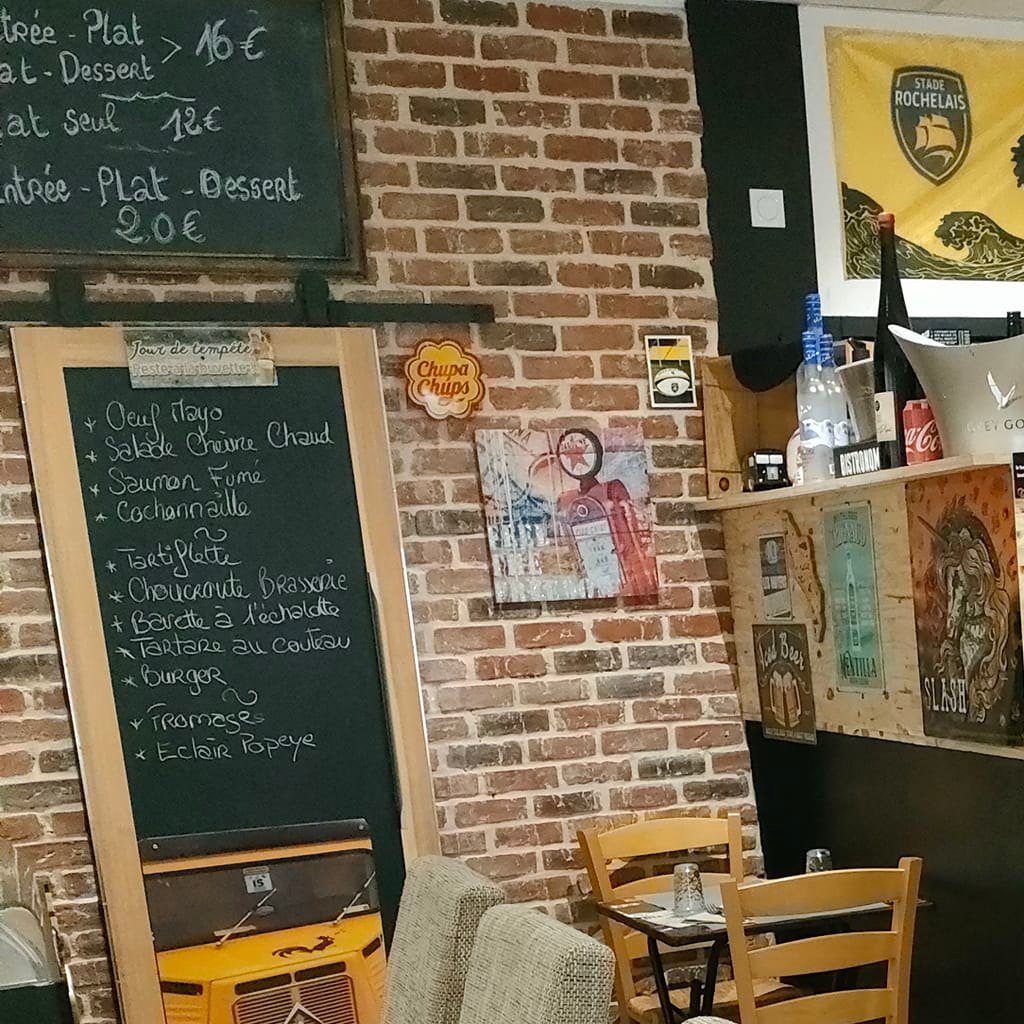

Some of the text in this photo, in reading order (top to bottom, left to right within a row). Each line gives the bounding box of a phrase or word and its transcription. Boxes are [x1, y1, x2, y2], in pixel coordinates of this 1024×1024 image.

[0, 7, 56, 44] trée
[83, 9, 144, 46] Plat
[60, 51, 154, 85] Dessert
[914, 77, 945, 91] STADE
[895, 90, 966, 111] ROCHELAIS
[0, 104, 49, 138] at
[0, 163, 303, 207] ntrée Plat Dessert
[129, 340, 165, 360] Jour
[170, 340, 188, 355] de
[417, 361, 468, 384] Chupa
[417, 379, 470, 399] Chups
[106, 399, 223, 444] Oeuf Mayo
[105, 434, 177, 463] Salade
[267, 421, 335, 448] Chaud
[109, 466, 201, 495] Saumon
[128, 571, 250, 603] Choucroute
[130, 633, 225, 659] Tartare
[232, 638, 264, 655] au
[779, 631, 805, 671] Beer
[141, 664, 228, 696] Burger
[924, 676, 968, 714] SLASH
[240, 732, 317, 762] Popeye
